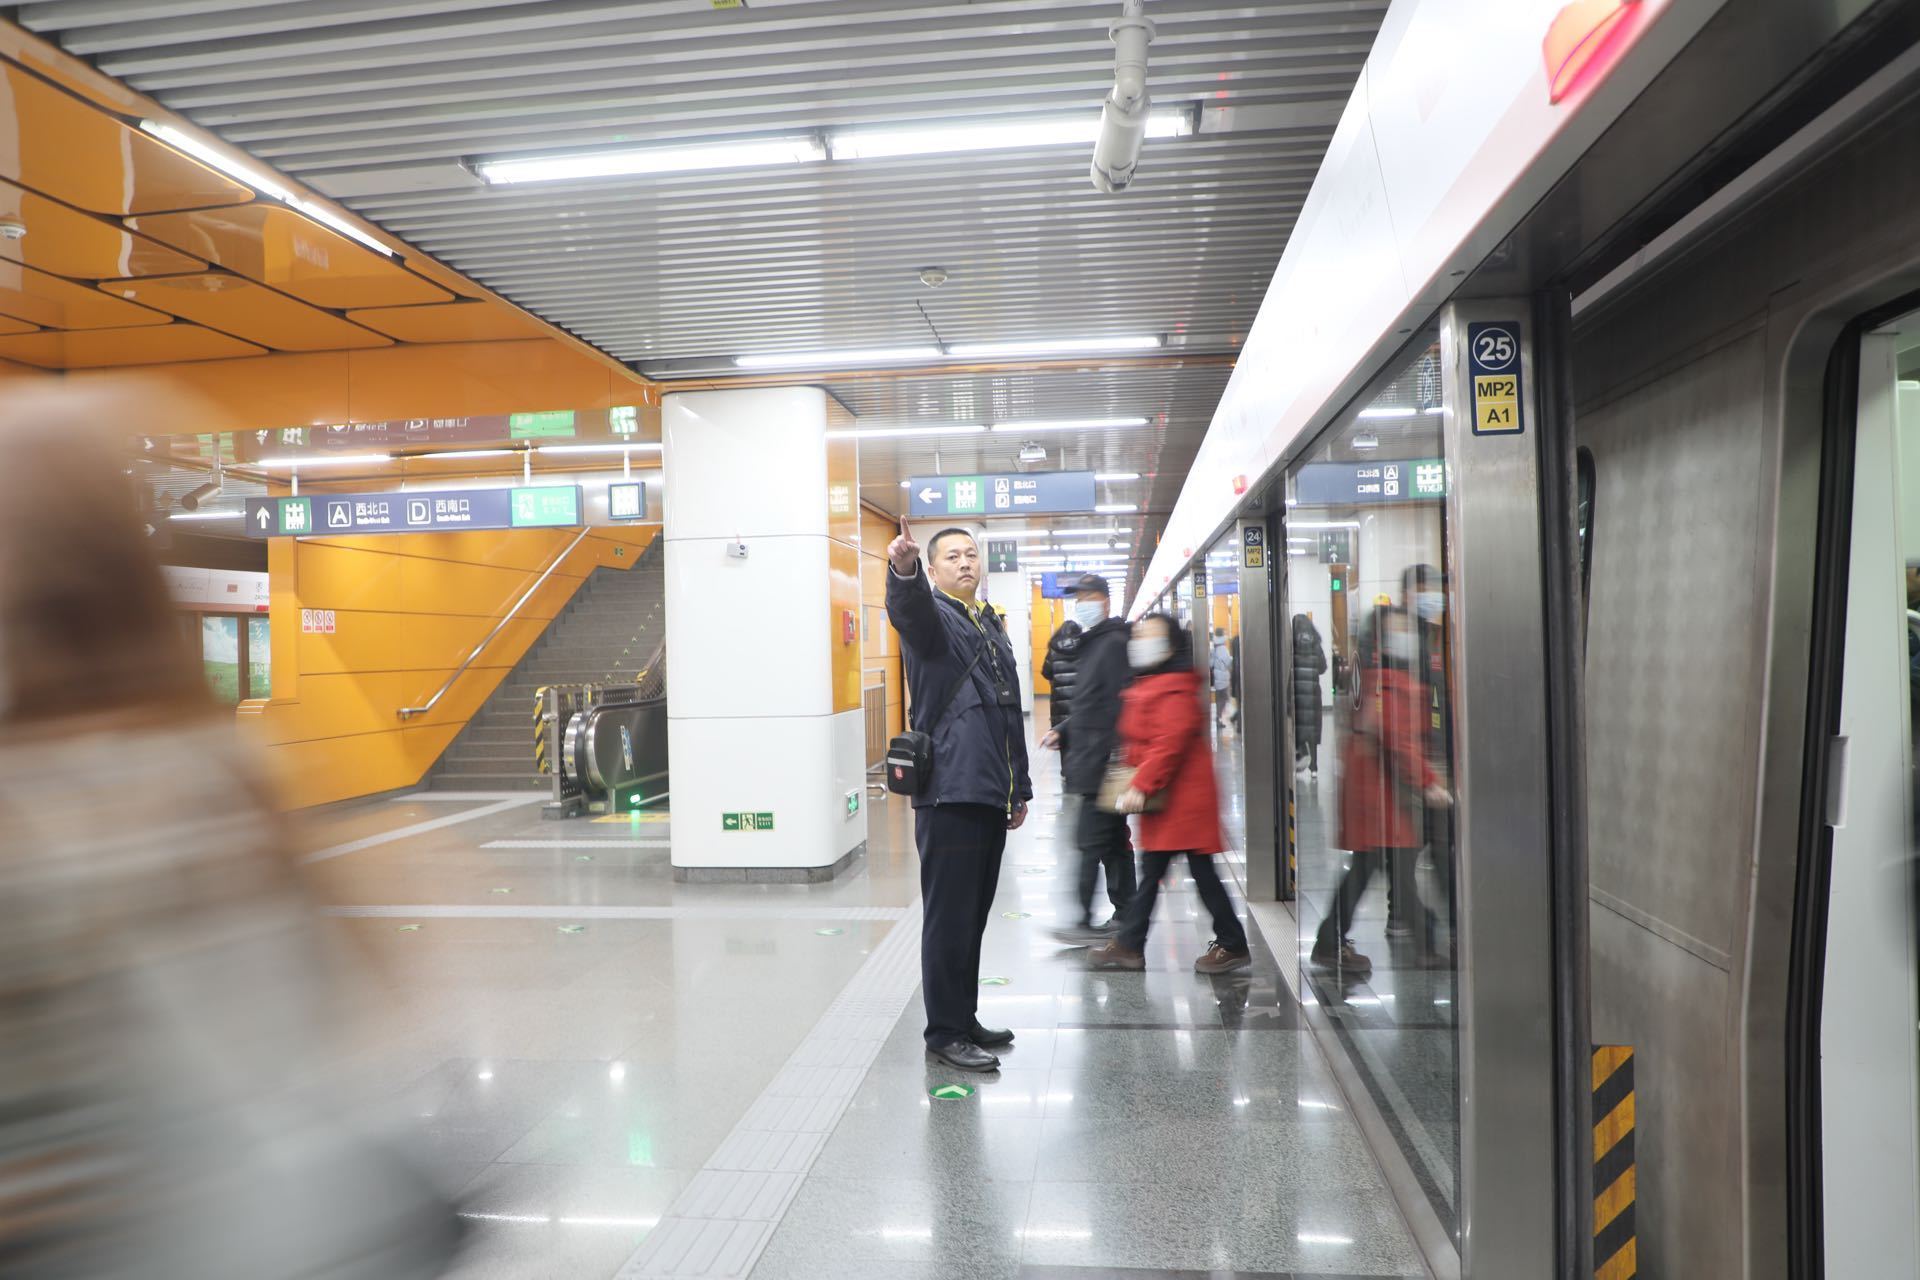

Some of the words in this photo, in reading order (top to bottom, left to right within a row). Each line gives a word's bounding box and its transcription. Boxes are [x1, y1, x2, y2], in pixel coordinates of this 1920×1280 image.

[1479, 336, 1511, 361] 25
[1478, 382, 1515, 397] MP2
[1487, 408, 1510, 424] A1
[355, 502, 389, 516] 西北口
[435, 499, 470, 513] 西南口
[955, 501, 977, 509] EXIT
[1247, 531, 1260, 542] 24
